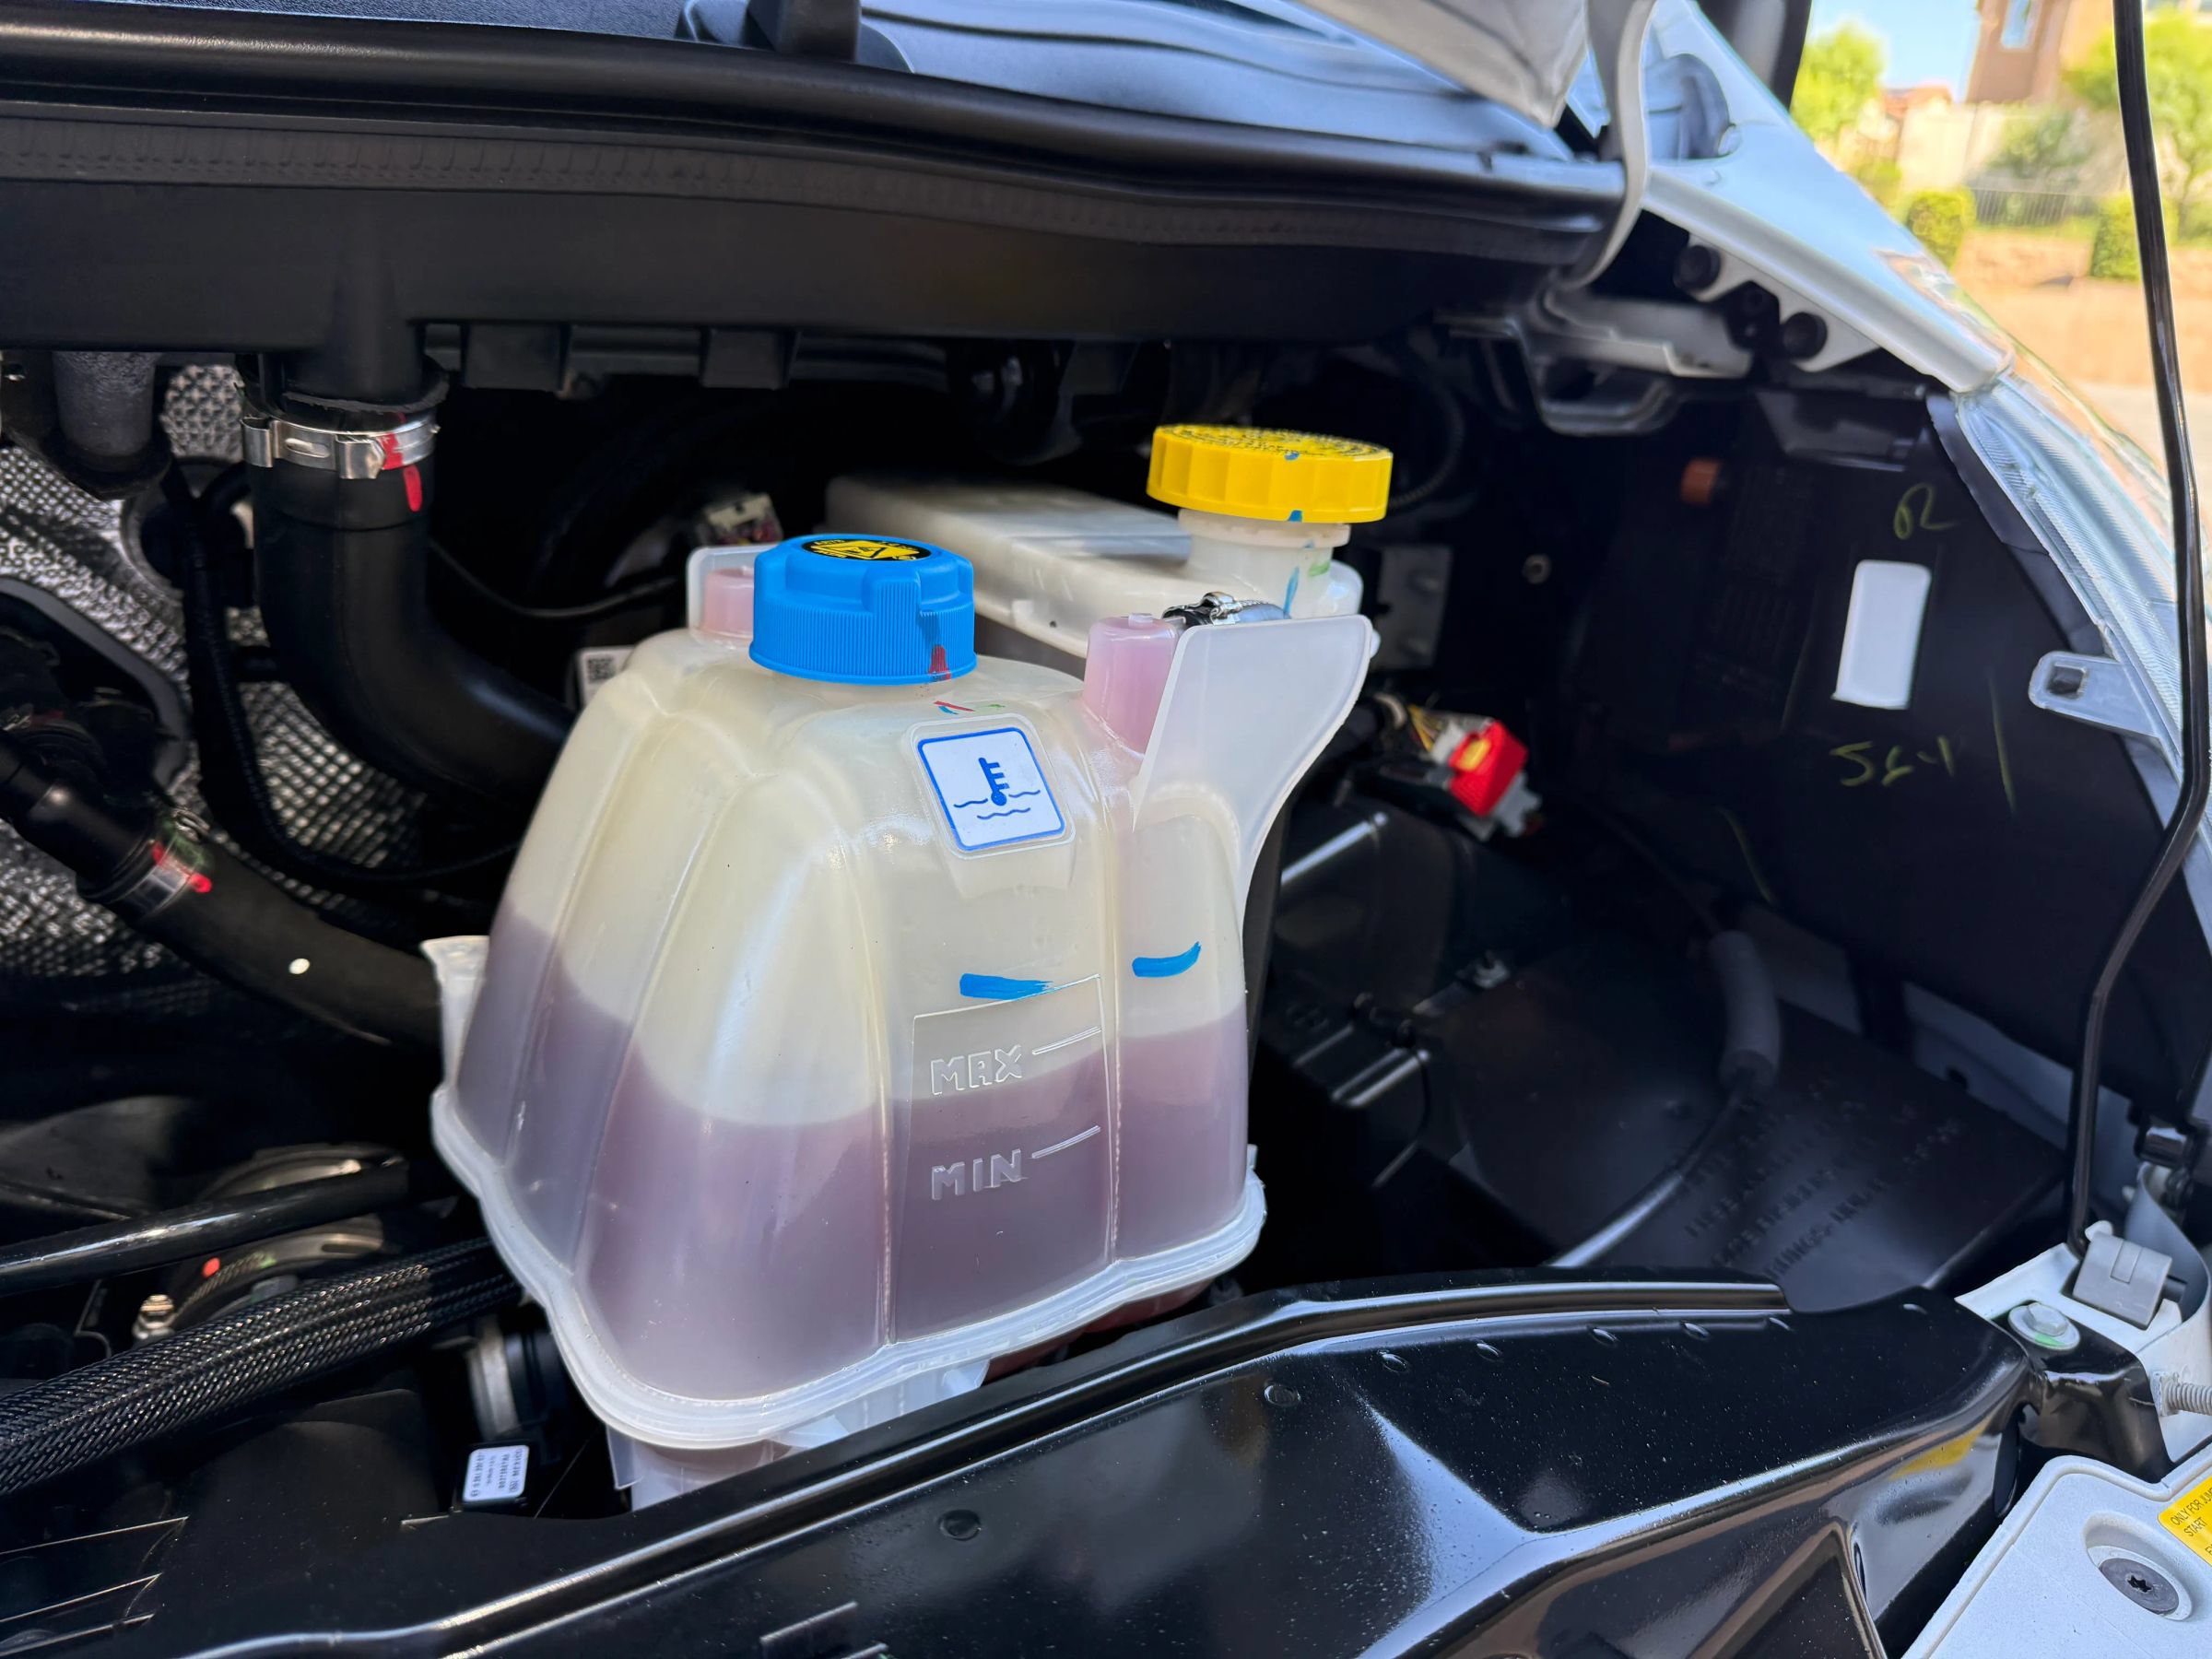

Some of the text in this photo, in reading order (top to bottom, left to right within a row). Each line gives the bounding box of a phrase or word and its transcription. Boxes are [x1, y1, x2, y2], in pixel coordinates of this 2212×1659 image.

[931, 1044, 1022, 1095] MAX
[932, 1148, 1022, 1200] MIN
[2171, 1507, 2190, 1525] ONLY
[2186, 1499, 2205, 1516] FOR
[2183, 1516, 2207, 1537] START
